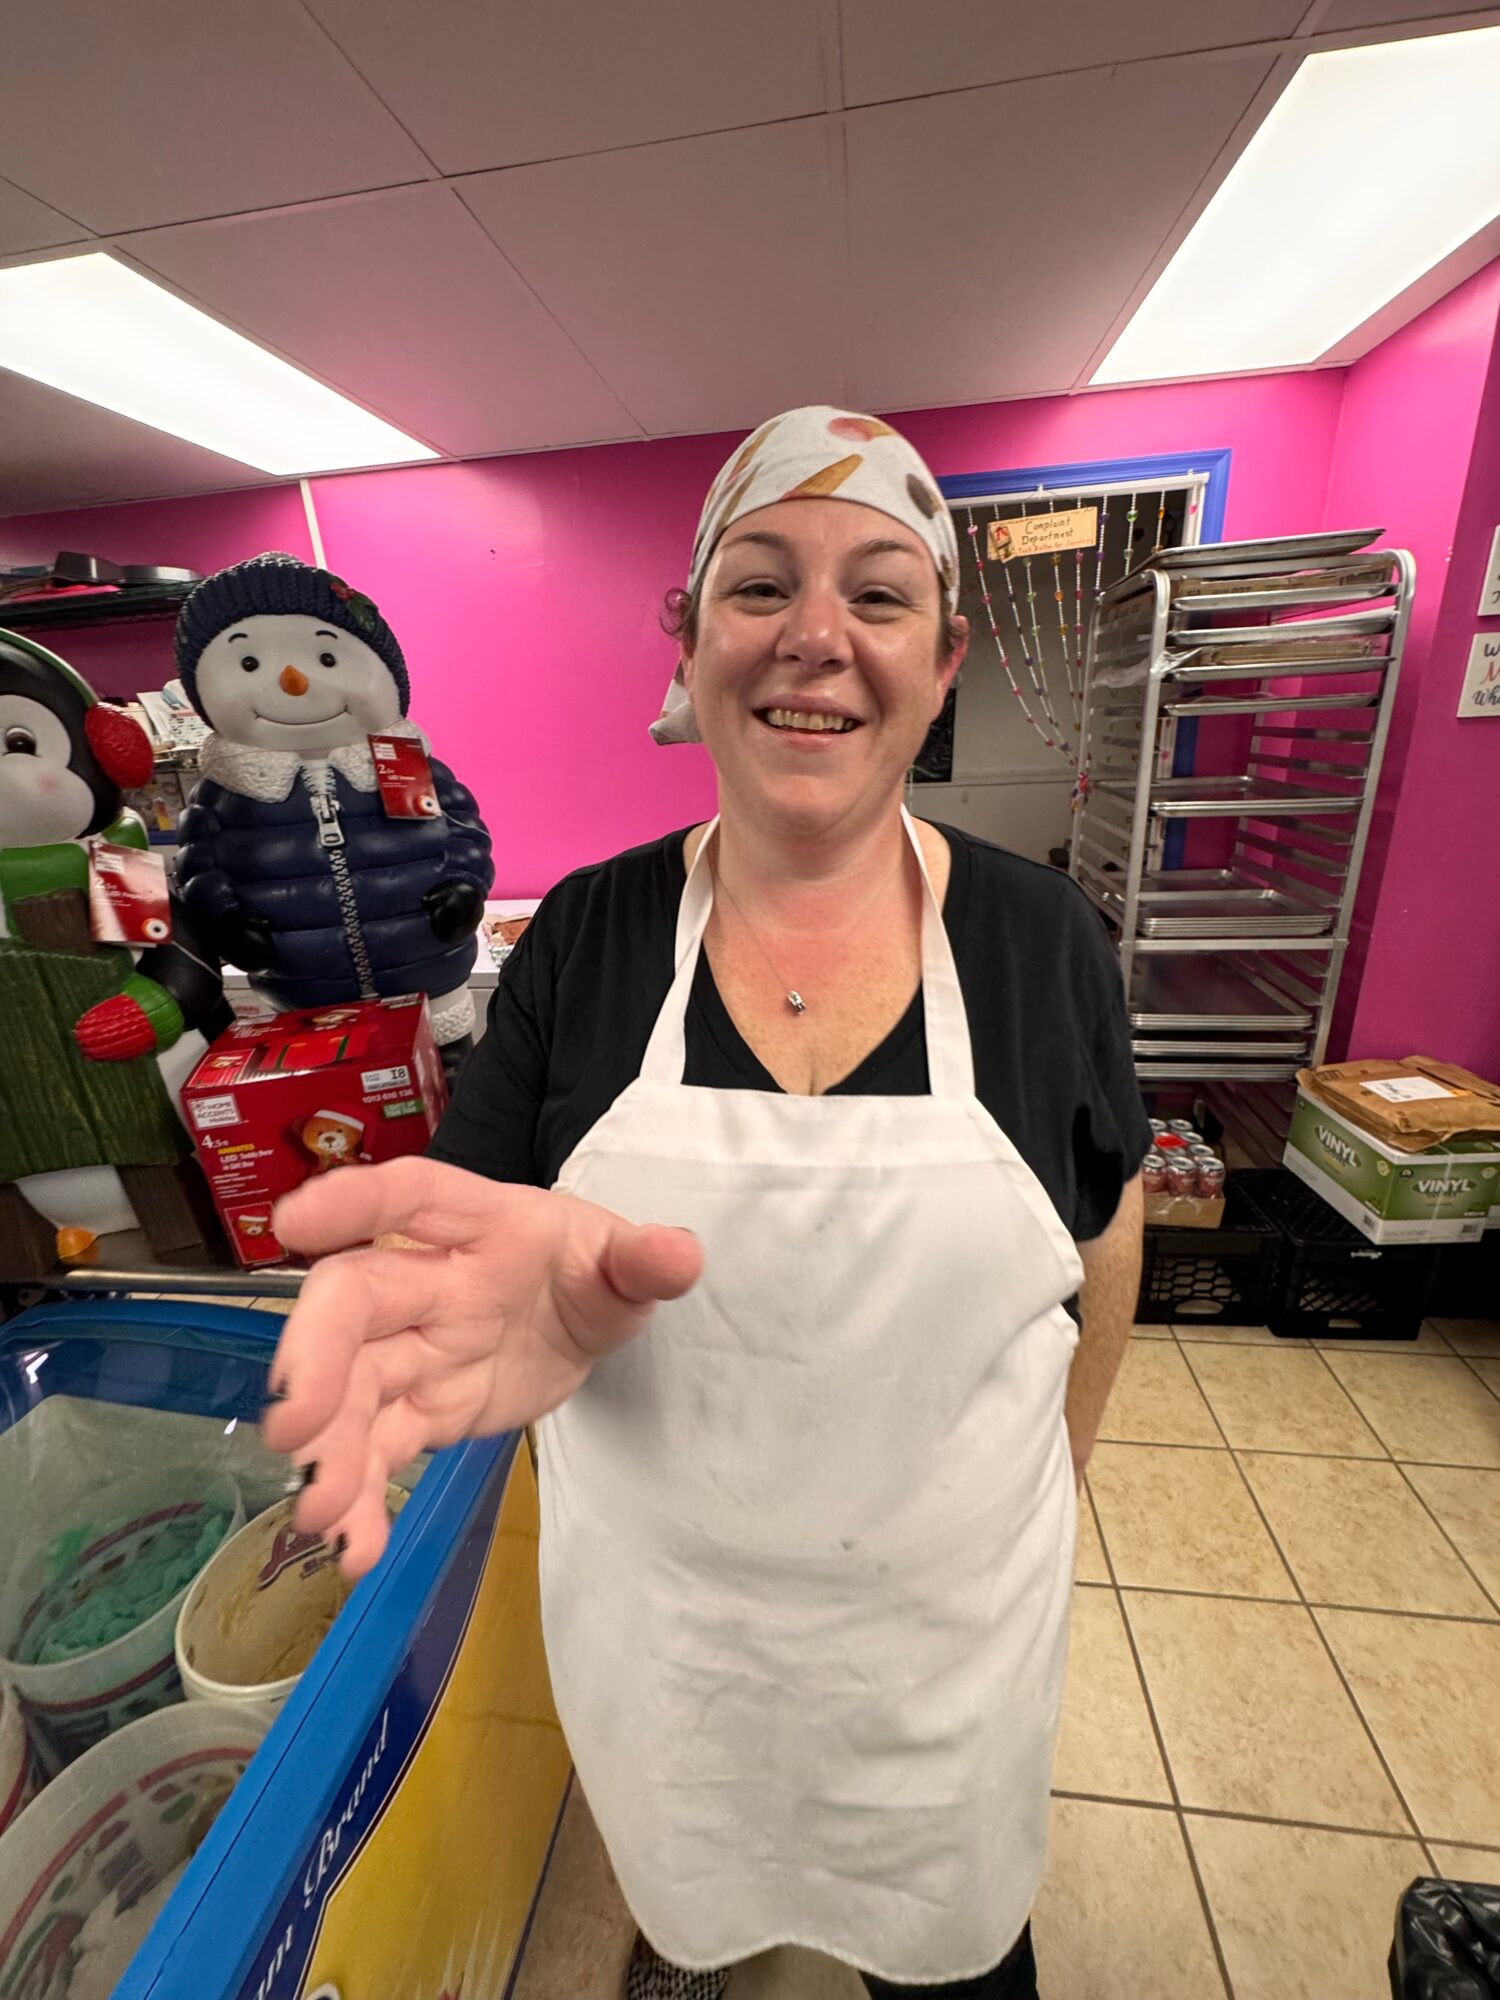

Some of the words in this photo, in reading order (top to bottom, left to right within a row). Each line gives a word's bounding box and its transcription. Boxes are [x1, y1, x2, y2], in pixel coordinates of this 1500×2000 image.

[1025, 516, 1070, 534] Complaint
[1021, 528, 1073, 545] Department
[1319, 1125, 1357, 1167] VINYL
[1418, 1178, 1471, 1193] VINYL
[304, 1707, 389, 1910] Brand
